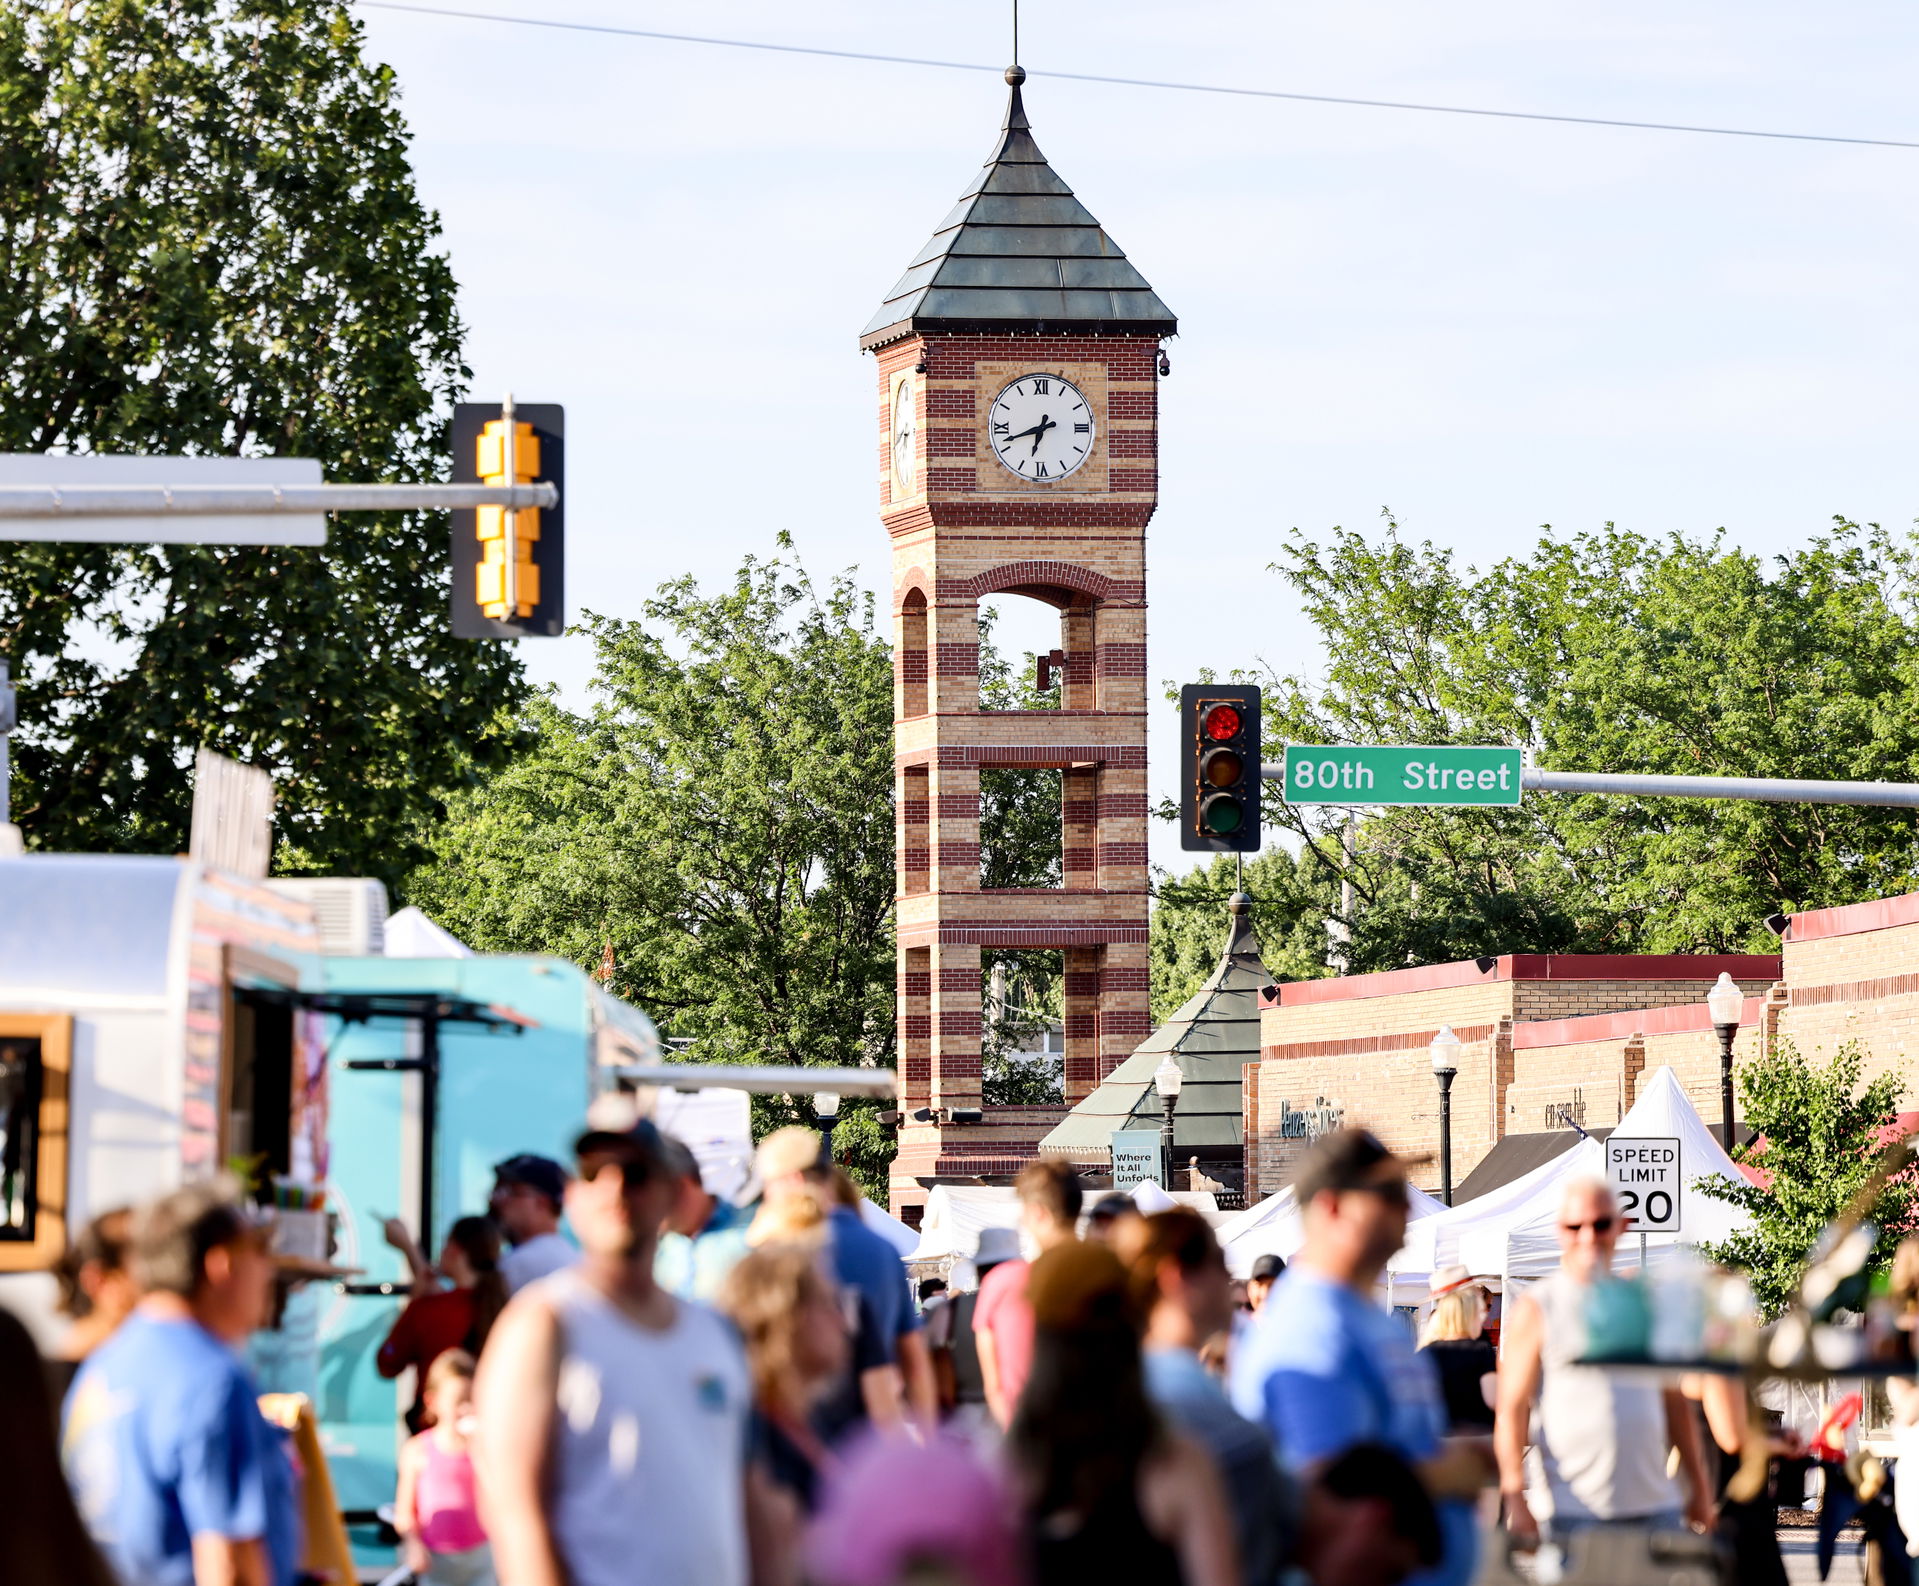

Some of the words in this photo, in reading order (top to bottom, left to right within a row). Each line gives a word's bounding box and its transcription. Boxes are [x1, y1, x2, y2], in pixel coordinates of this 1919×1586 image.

[1033, 379, 1049, 395] XII
[994, 421, 1009, 435] IX
[1074, 421, 1089, 434] III
[1294, 760, 1374, 789] 80th
[1403, 761, 1511, 790] Street
[1612, 1149, 1674, 1163] SPEED
[1619, 1168, 1667, 1182] LIMIT
[1618, 1190, 1673, 1223] 20
